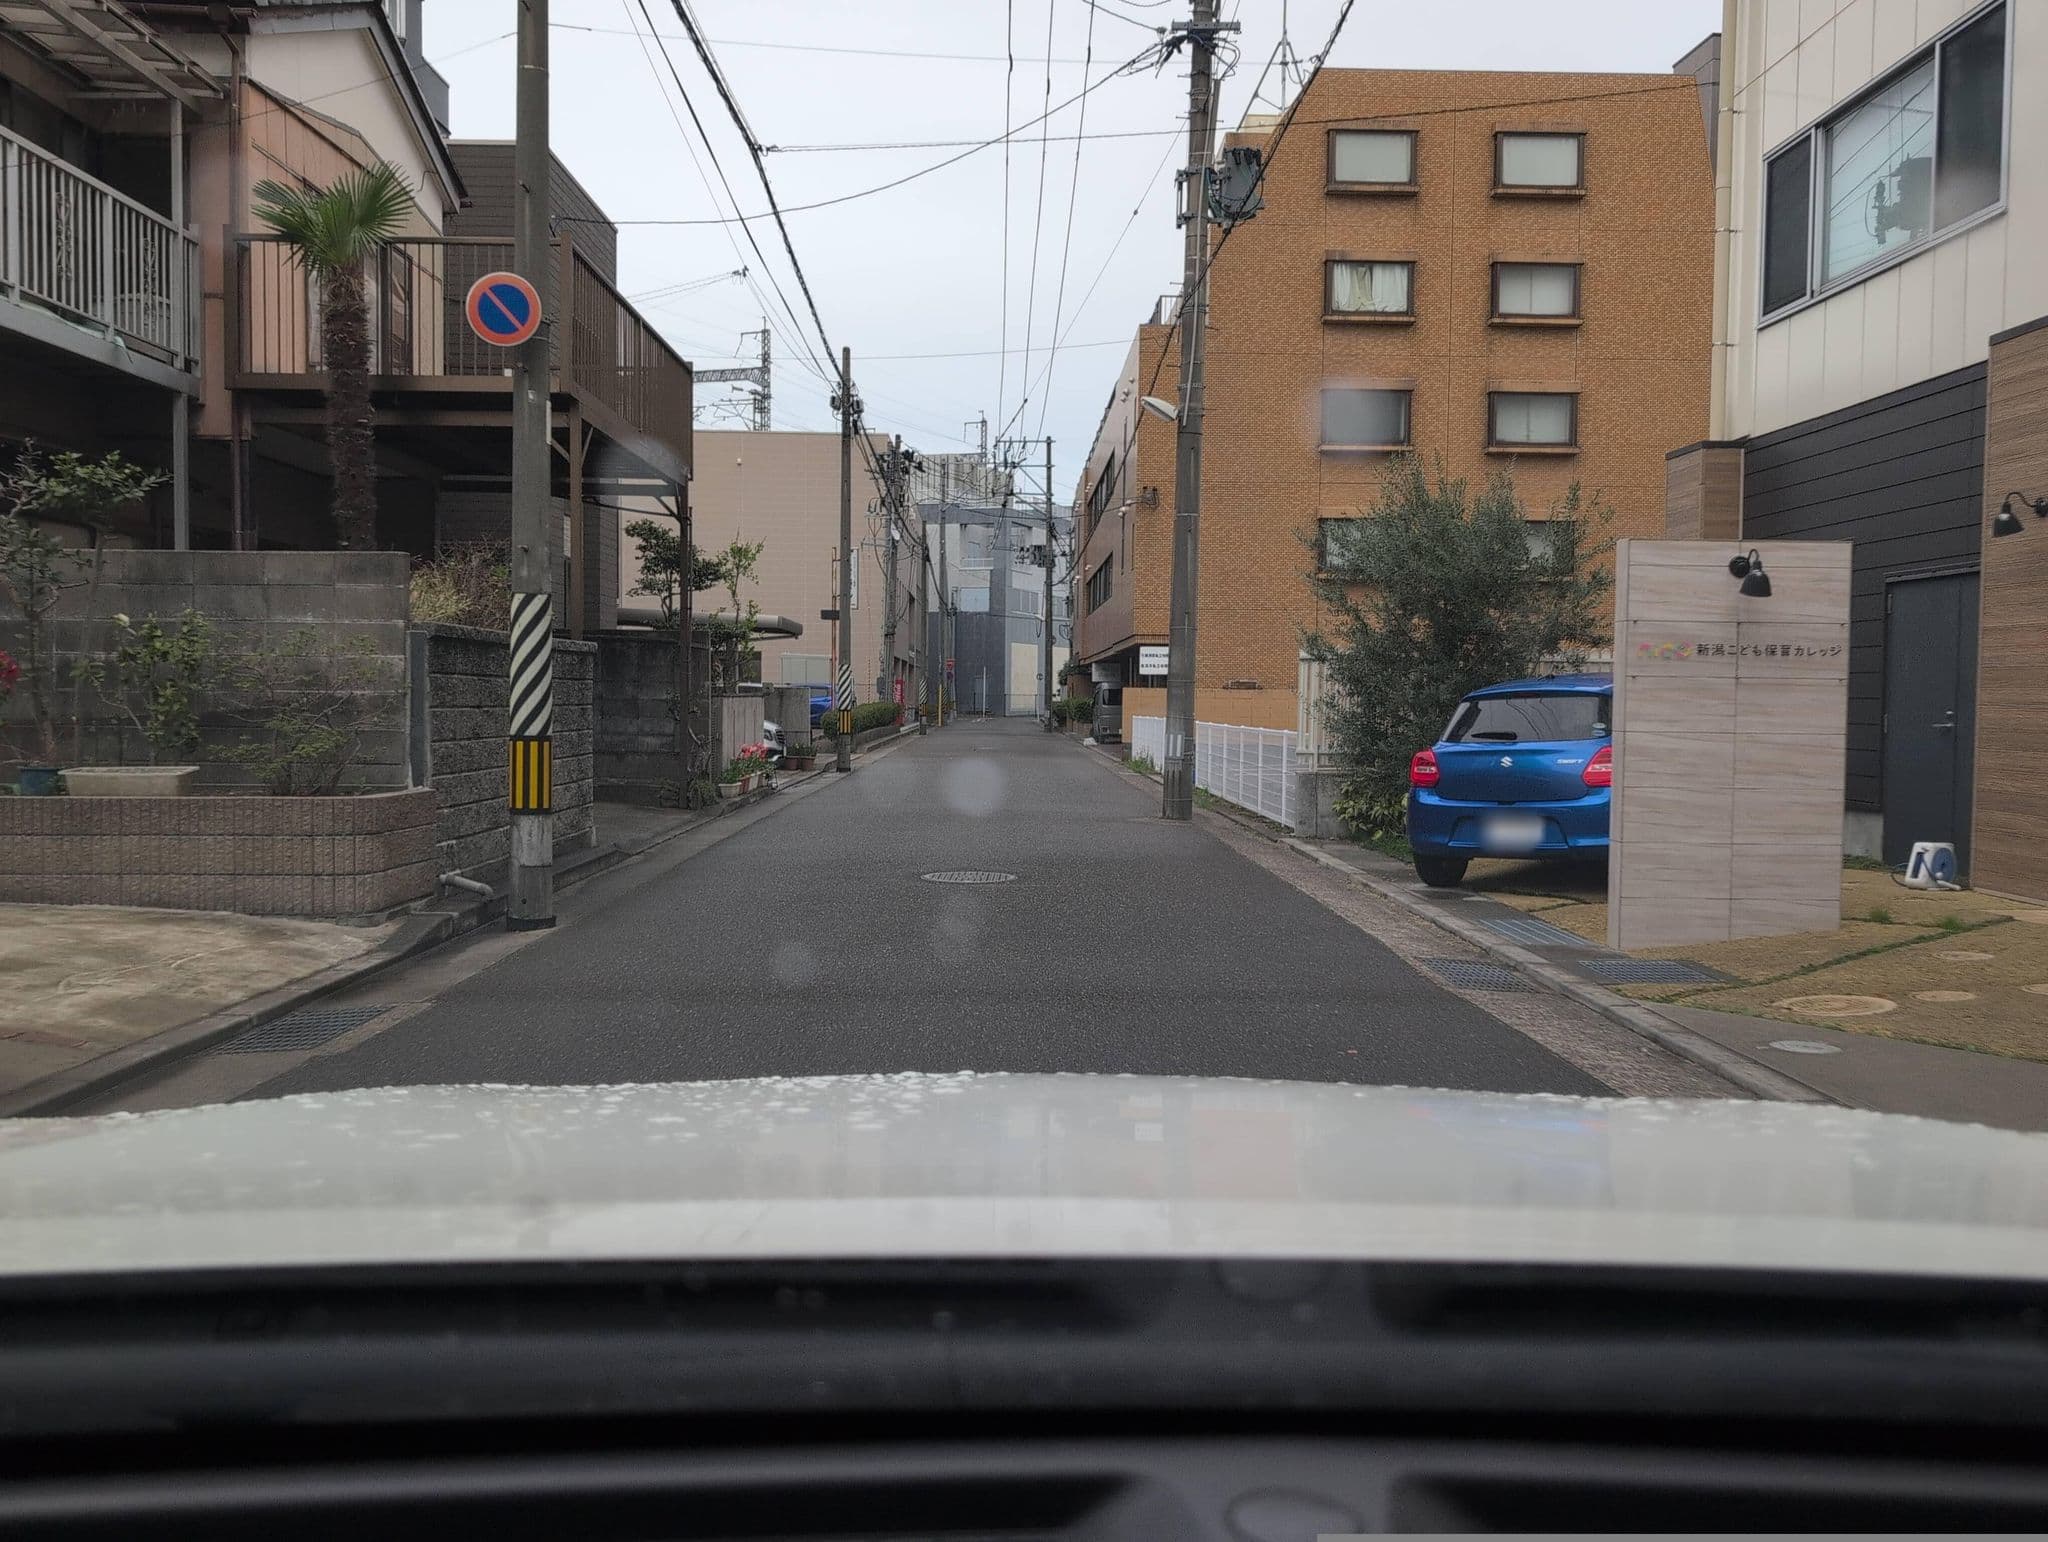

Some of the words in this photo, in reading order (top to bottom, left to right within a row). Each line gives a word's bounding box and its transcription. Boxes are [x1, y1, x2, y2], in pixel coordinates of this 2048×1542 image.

[1696, 643, 1842, 657] 新潟こども保育カレッジ
